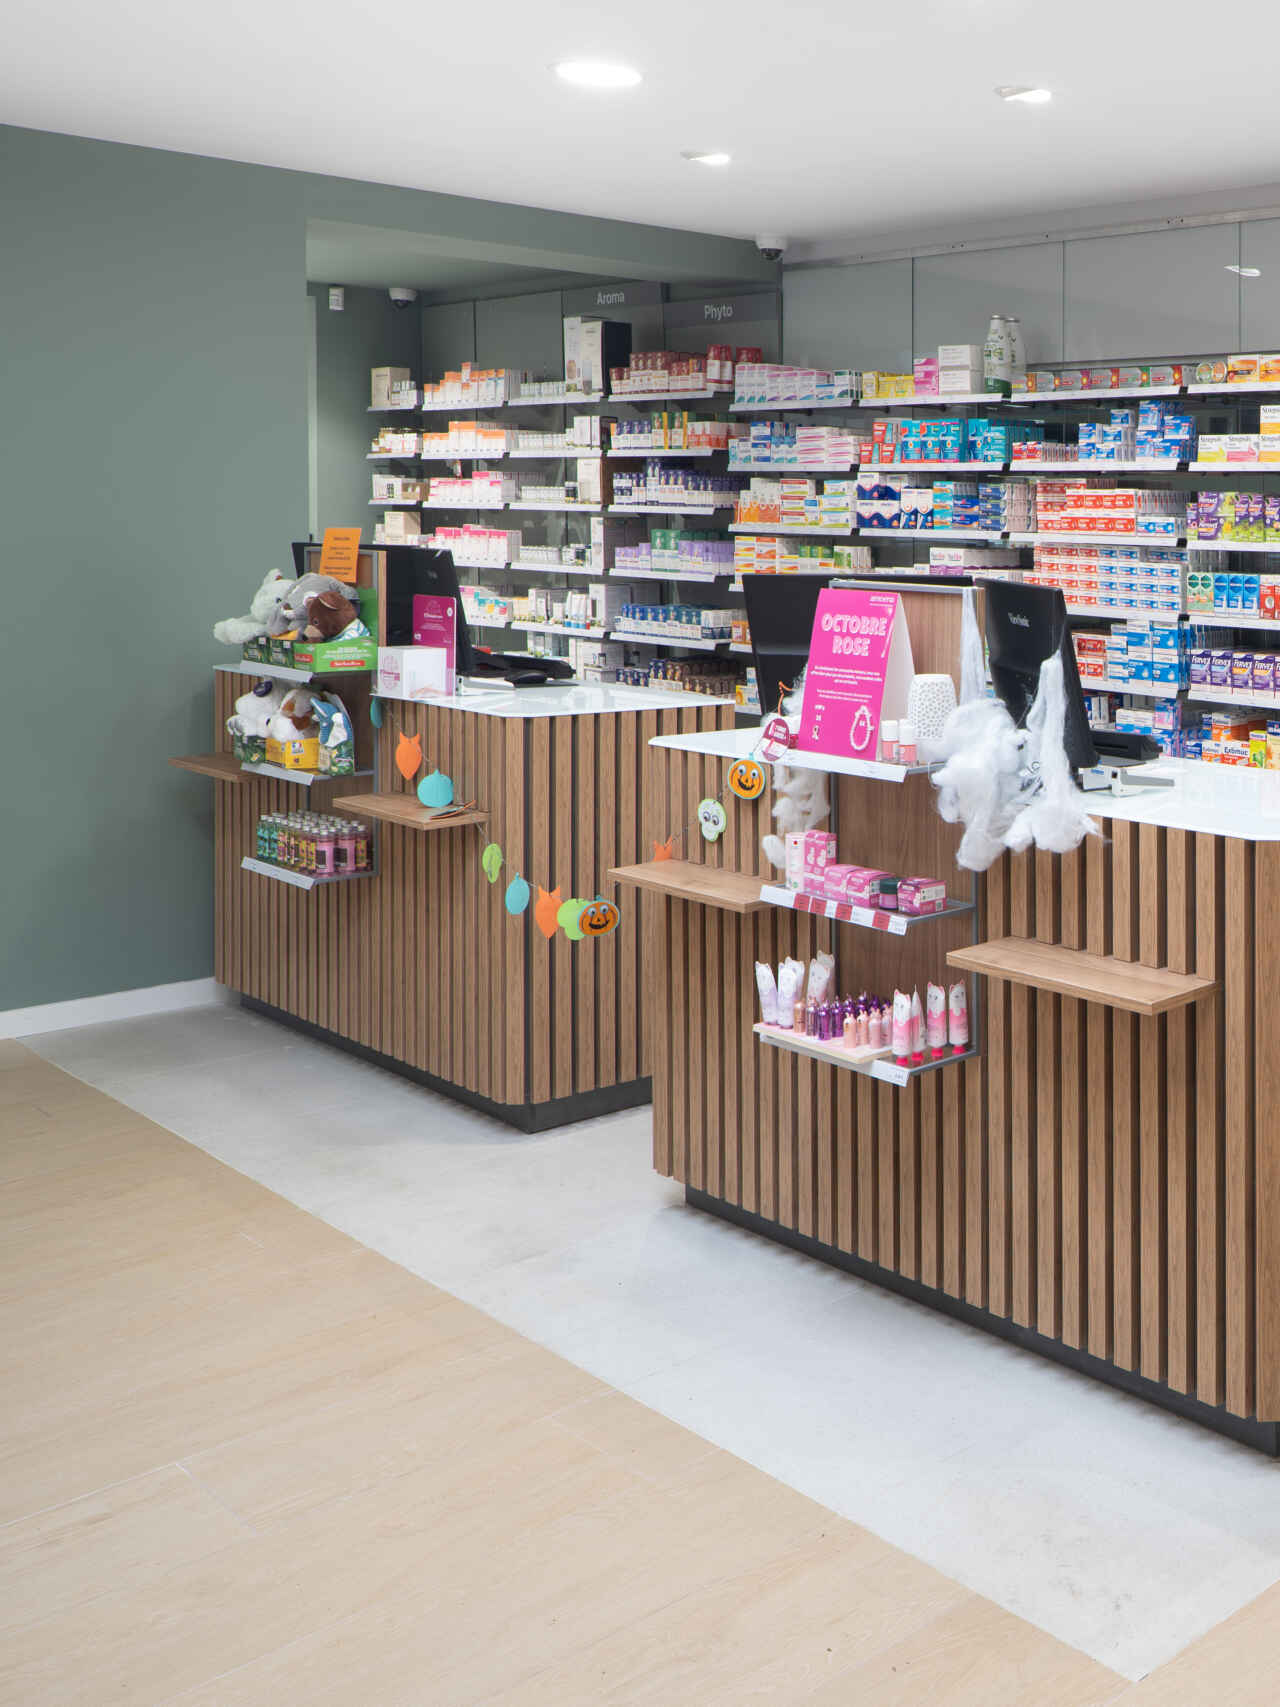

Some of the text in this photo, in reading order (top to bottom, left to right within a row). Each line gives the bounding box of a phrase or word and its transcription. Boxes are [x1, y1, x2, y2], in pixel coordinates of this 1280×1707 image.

[597, 291, 625, 304] Aroma
[704, 305, 734, 320] Phyto
[822, 613, 888, 636] OCTOBRE
[832, 635, 871, 656] ROSE
